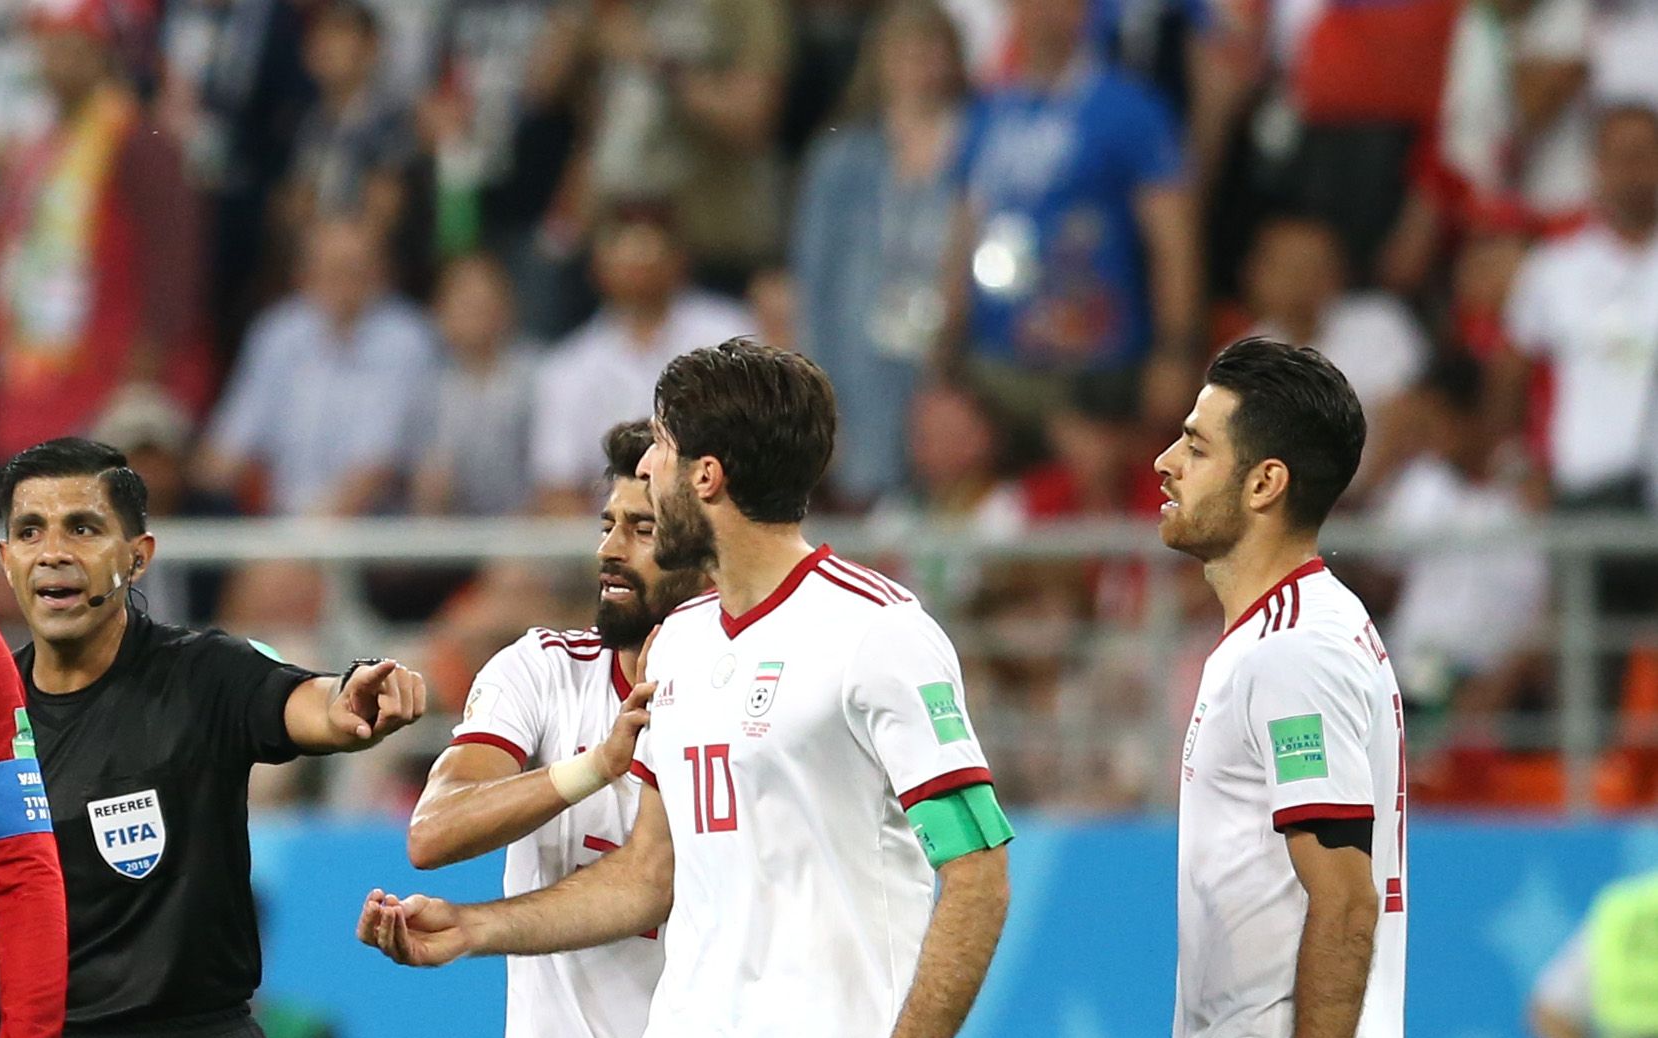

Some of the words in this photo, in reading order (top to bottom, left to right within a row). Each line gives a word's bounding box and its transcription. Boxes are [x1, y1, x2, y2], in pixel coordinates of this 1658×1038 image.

[684, 743, 738, 833] 10
[94, 797, 154, 818] REFEREE
[104, 823, 157, 848] FIFA
[126, 859, 151, 873] 2018
